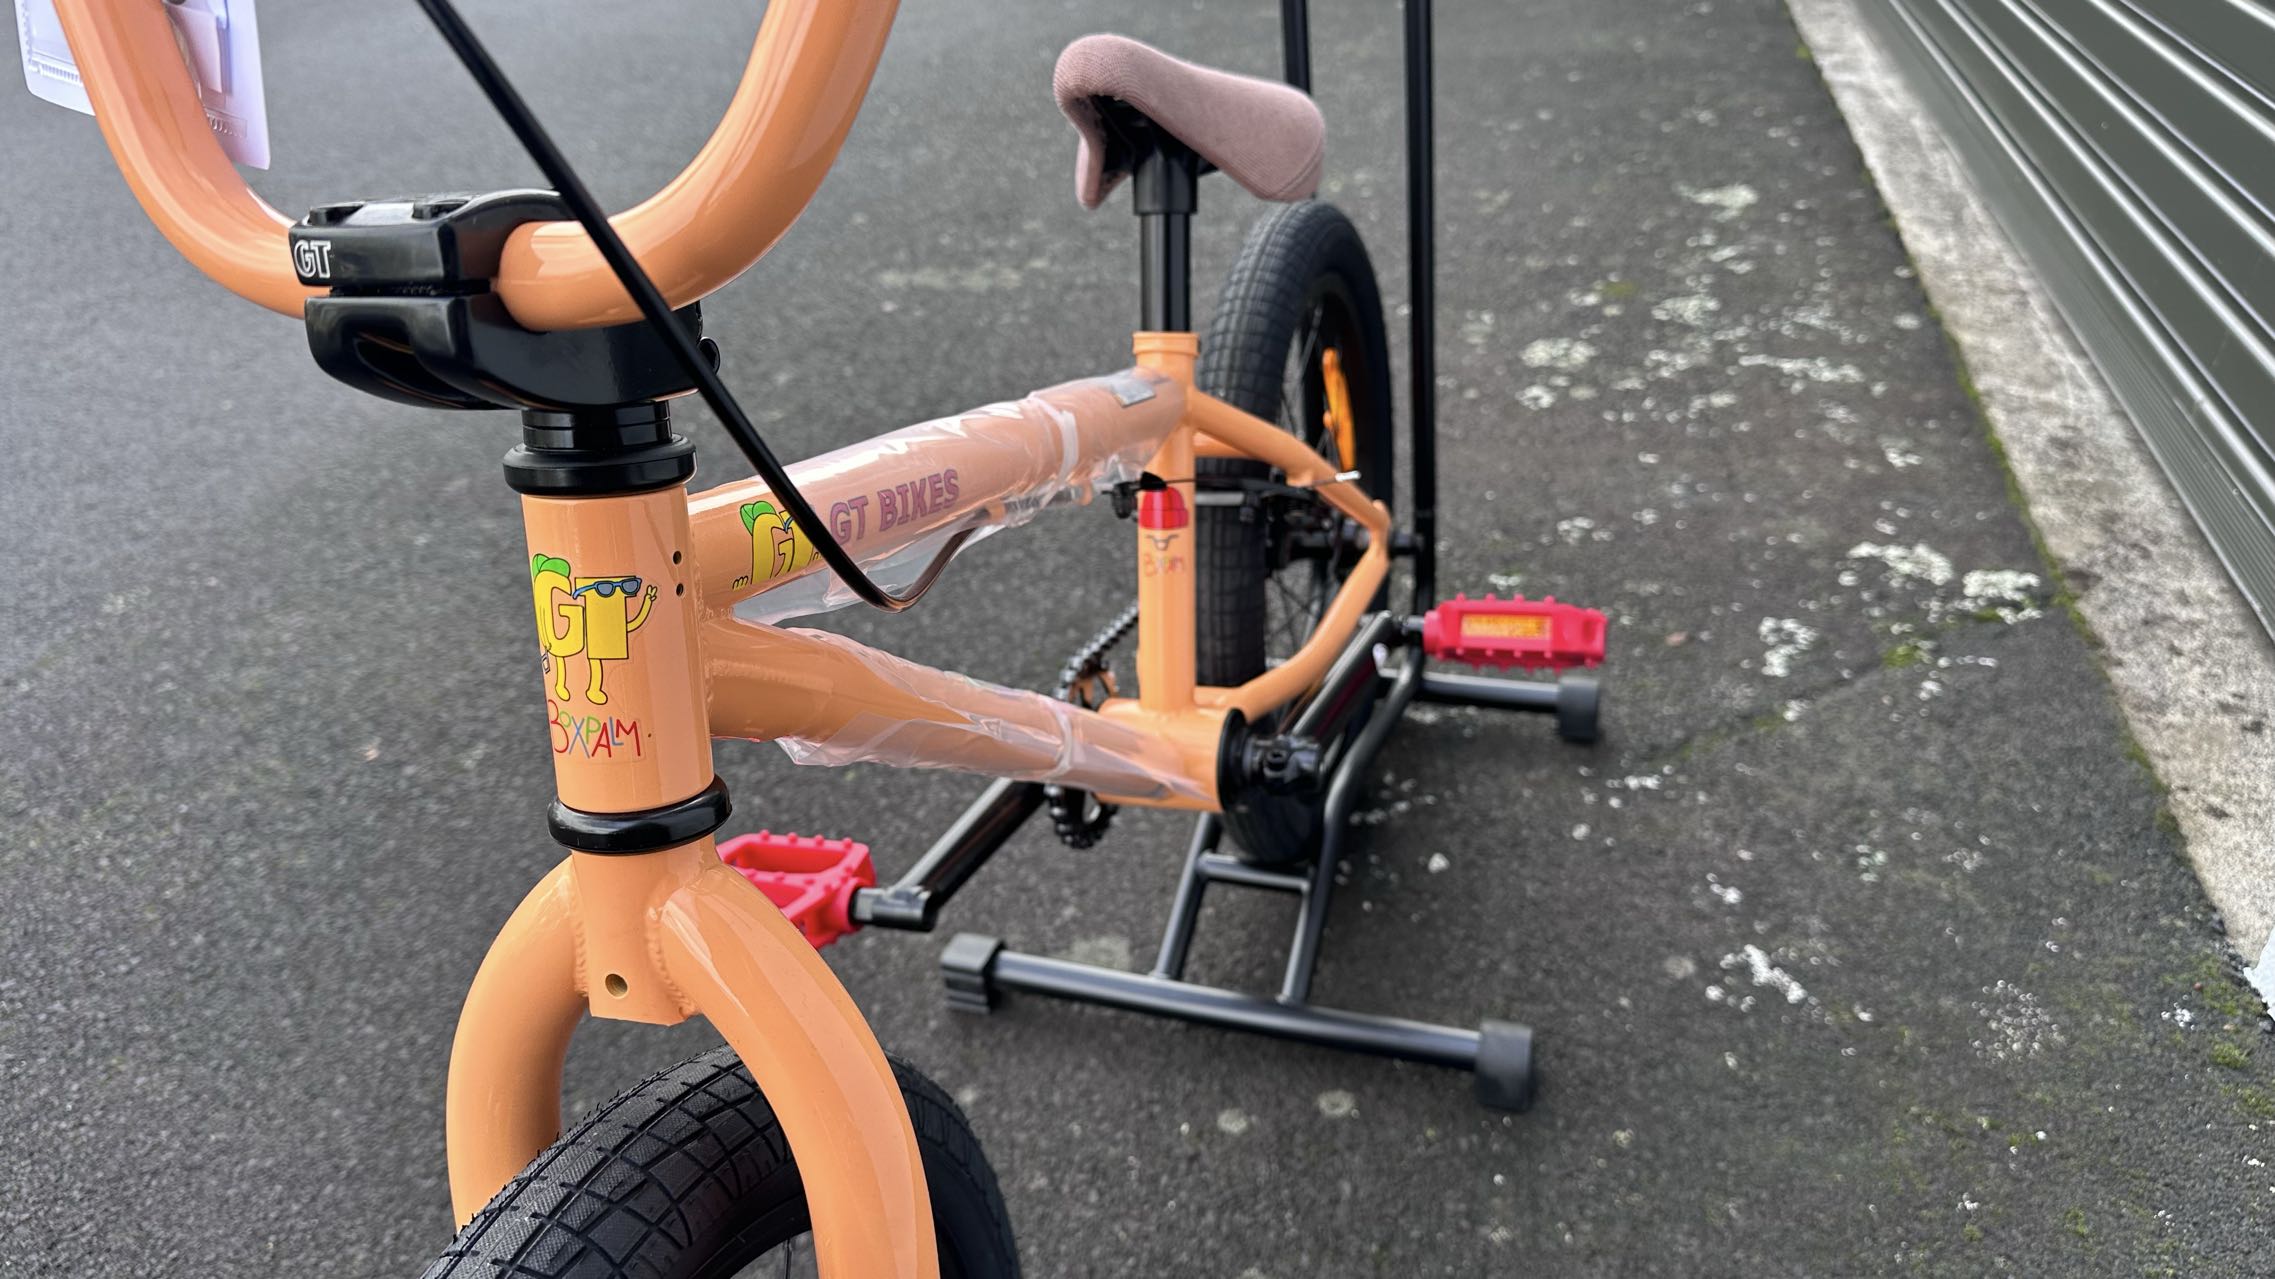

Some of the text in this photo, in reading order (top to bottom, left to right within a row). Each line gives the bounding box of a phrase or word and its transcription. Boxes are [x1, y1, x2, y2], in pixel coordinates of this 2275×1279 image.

[294, 239, 332, 279] GT
[829, 468, 960, 546] GT BIKES
[533, 567, 639, 660] GT
